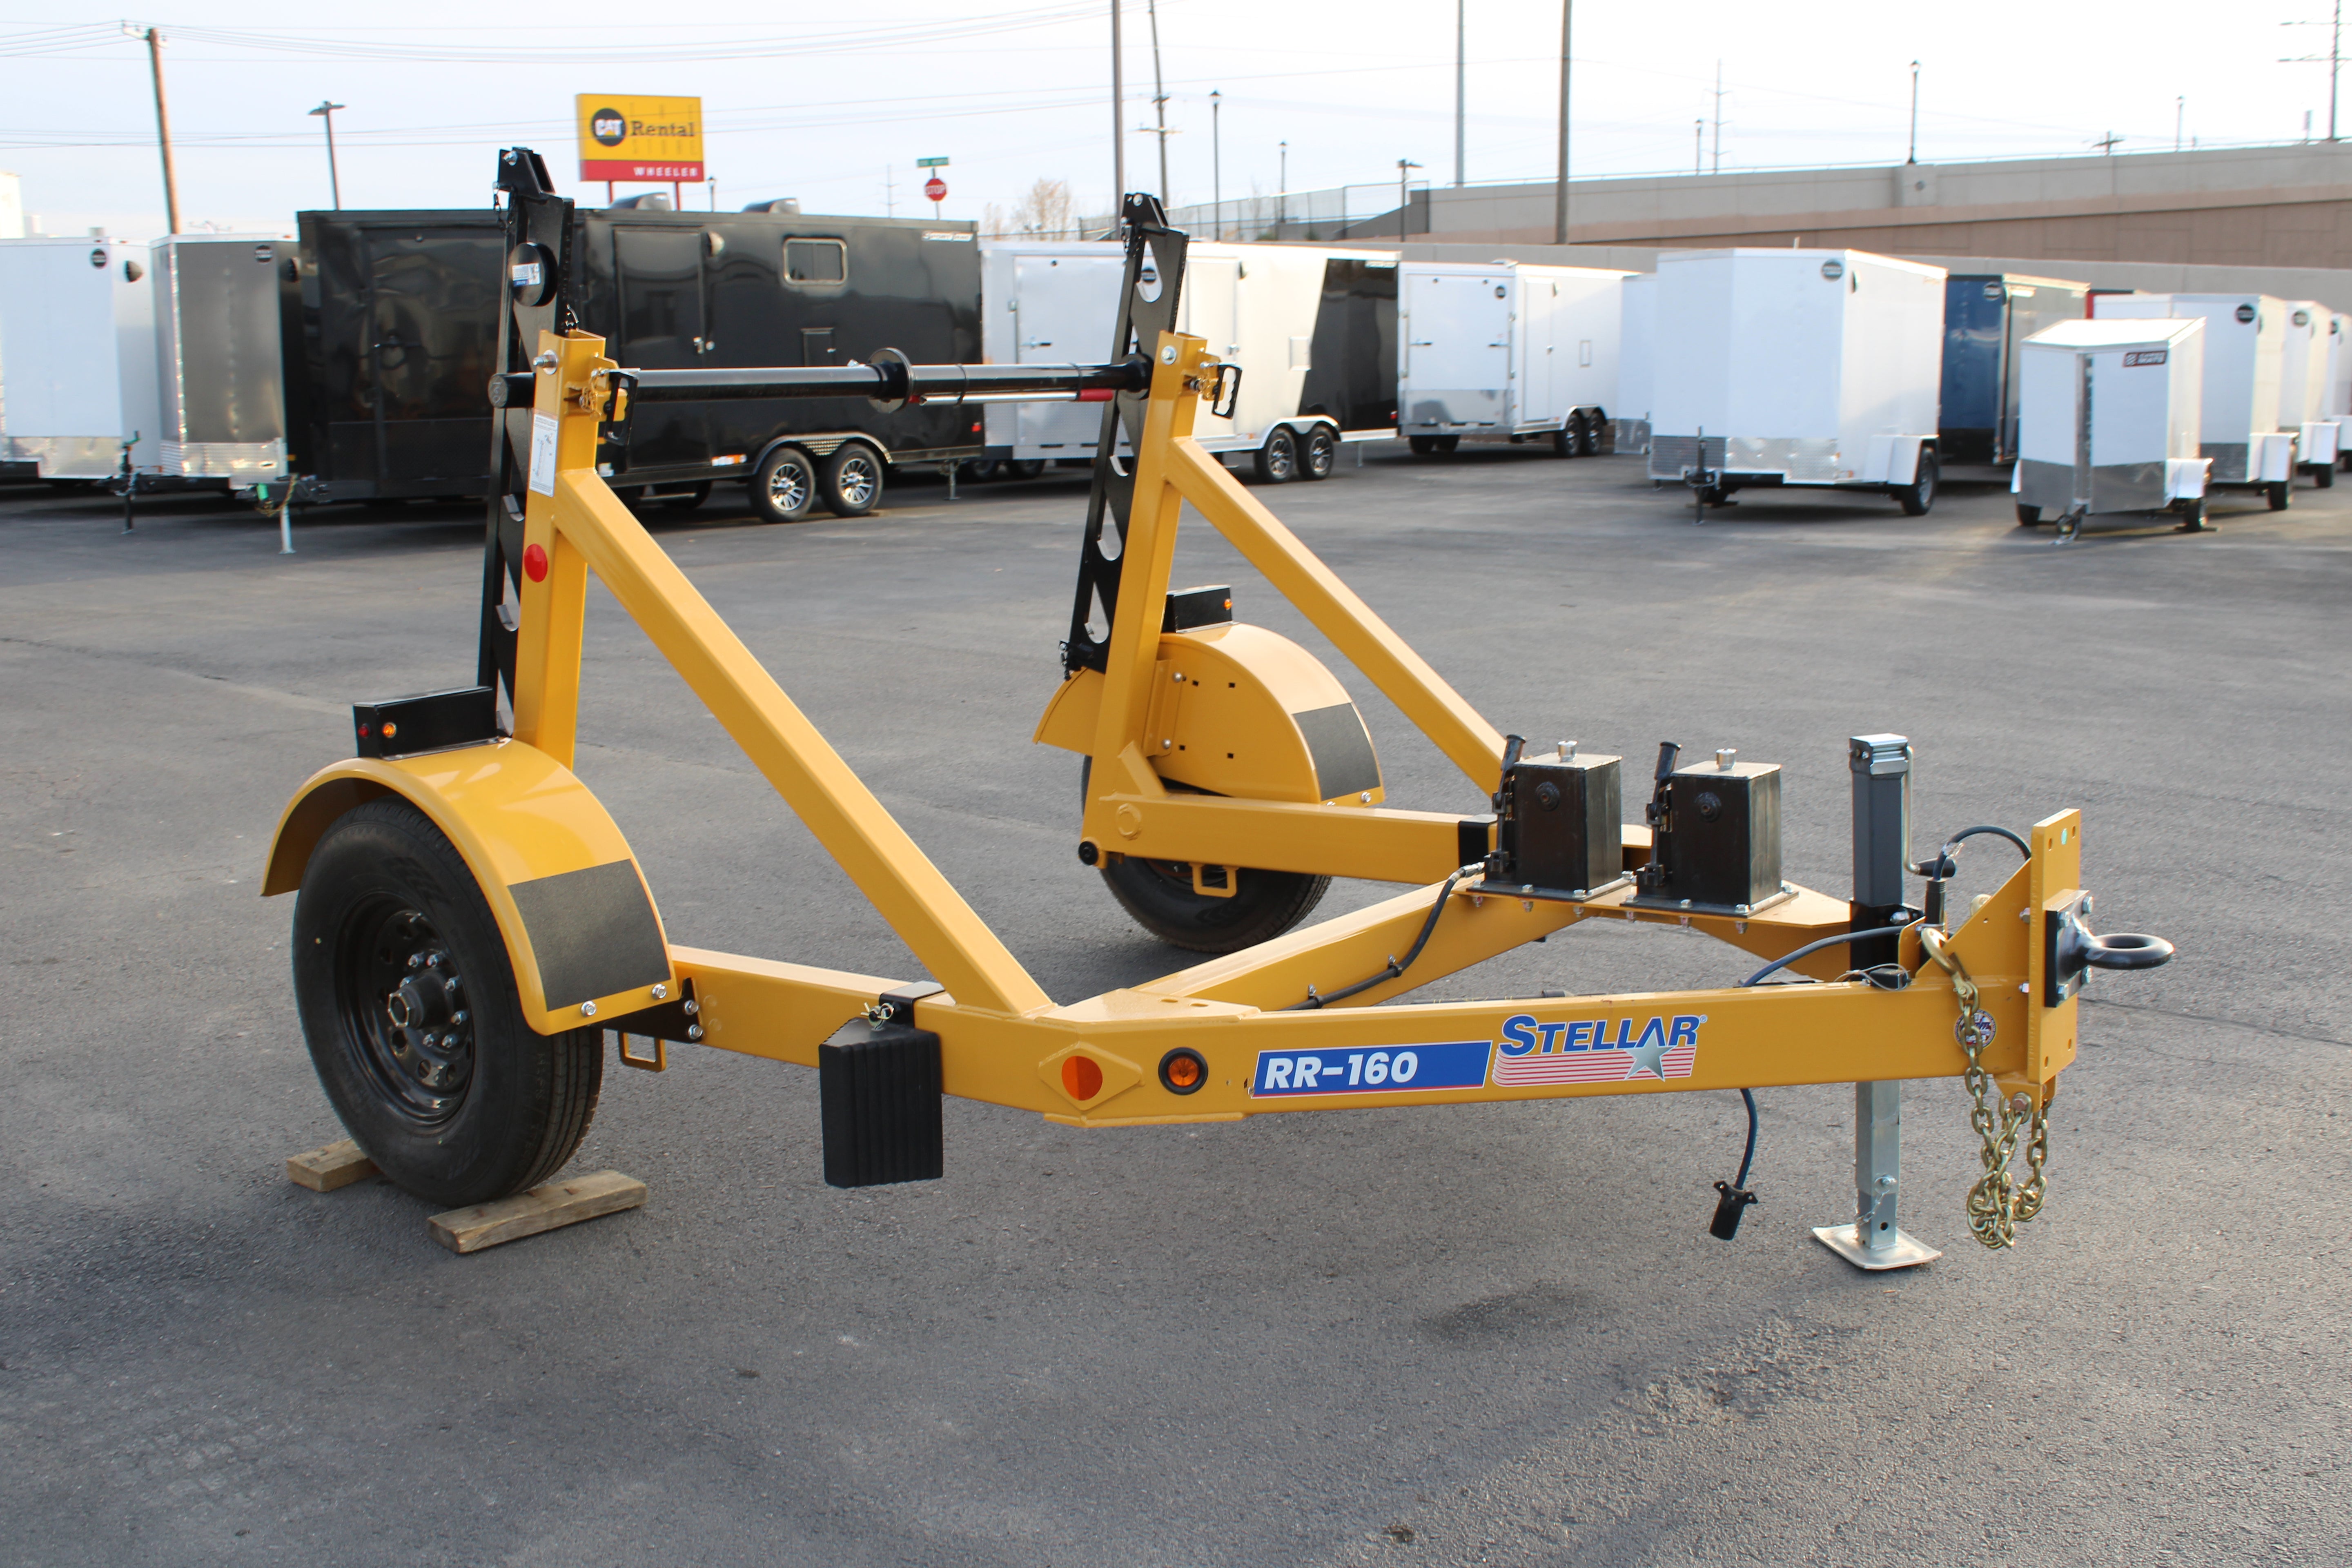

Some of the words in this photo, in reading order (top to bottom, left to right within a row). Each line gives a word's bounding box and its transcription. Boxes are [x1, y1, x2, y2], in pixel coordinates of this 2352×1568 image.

[594, 118, 623, 137] CAT
[630, 120, 695, 137] Rental
[634, 166, 699, 177] WHEELER
[924, 185, 946, 196] STOP
[1498, 1014, 1701, 1057] STELLAR
[1264, 1051, 1418, 1089] RR-160
